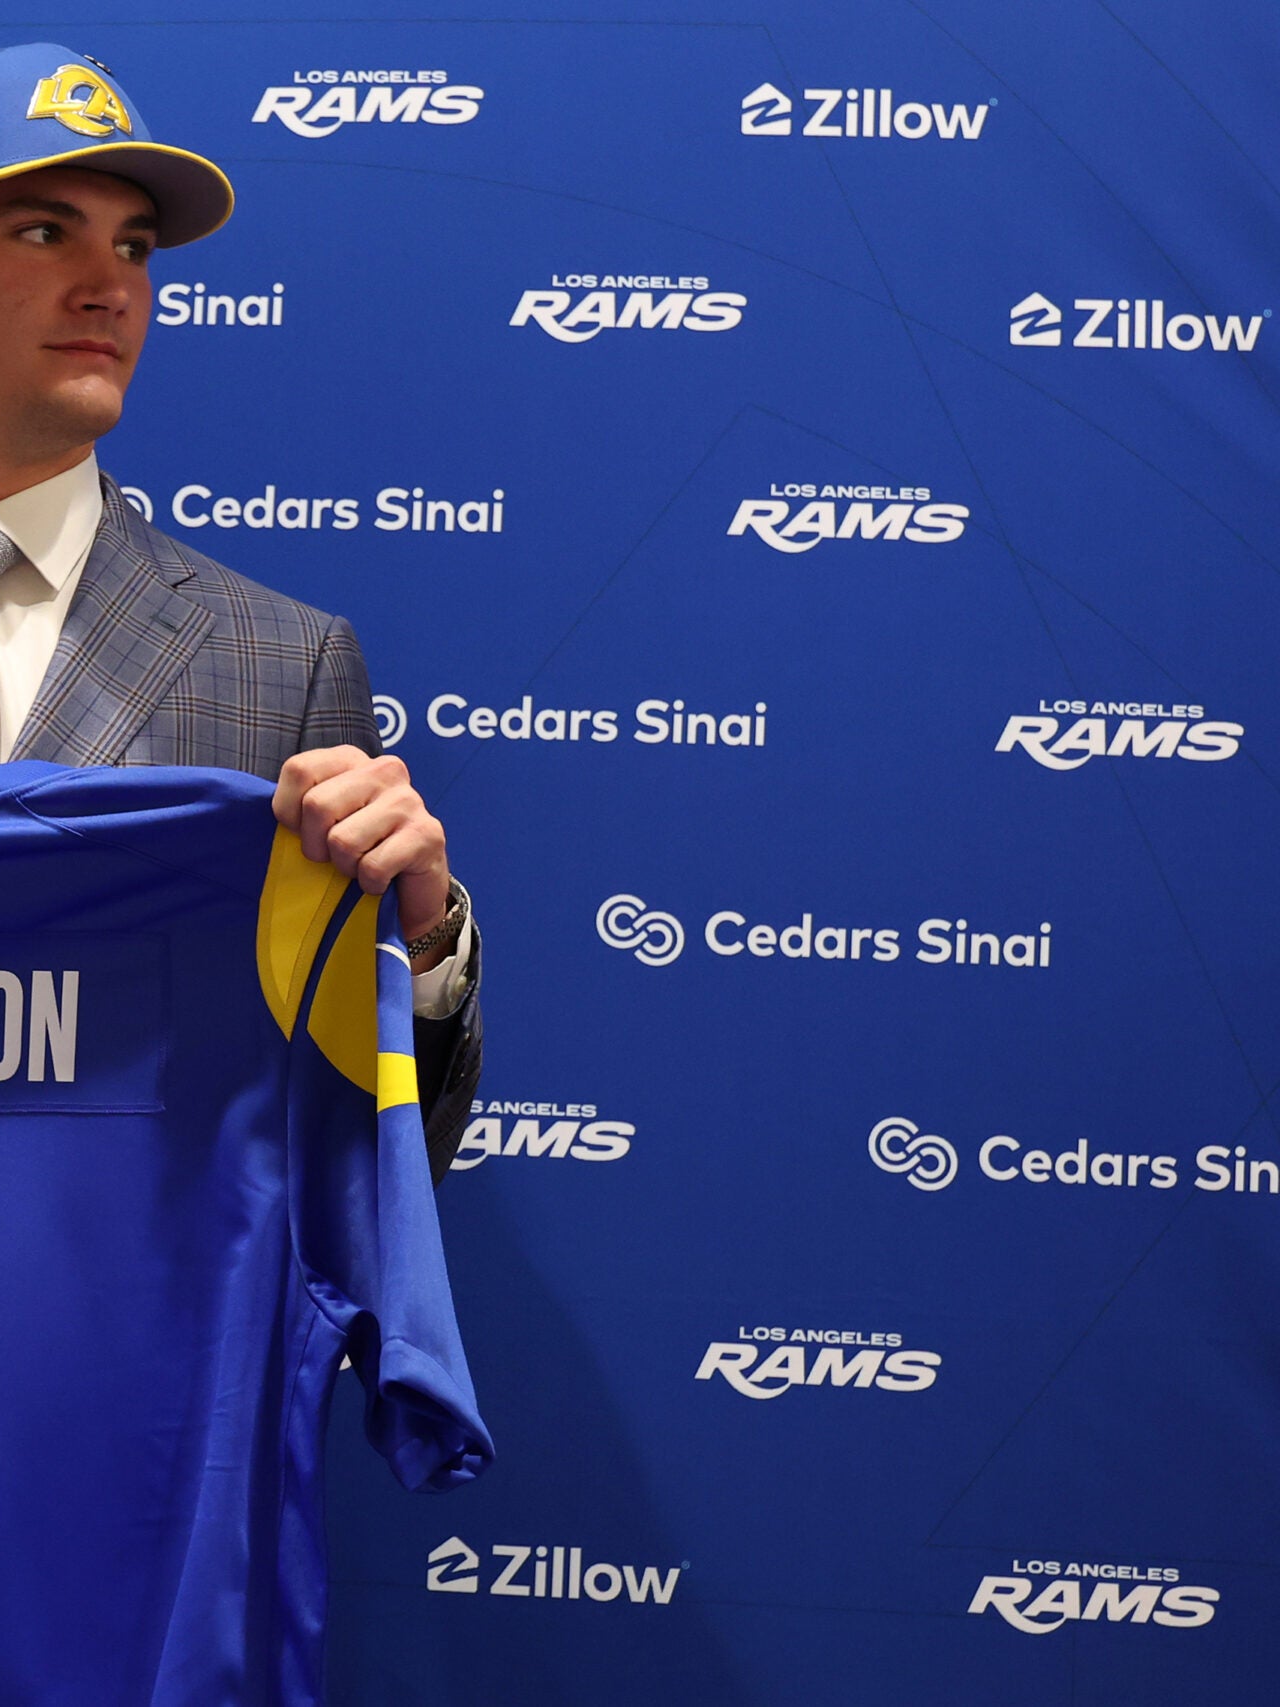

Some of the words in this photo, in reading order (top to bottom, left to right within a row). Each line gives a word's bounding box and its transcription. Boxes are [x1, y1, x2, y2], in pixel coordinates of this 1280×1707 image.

[294, 70, 339, 82] LOS
[341, 71, 447, 83] ANGELES
[252, 86, 484, 138] RAMS
[803, 88, 988, 139] Zillow
[156, 283, 284, 326] Sinai
[552, 275, 597, 288] LOS
[601, 276, 709, 290] ANGELES
[509, 290, 747, 343] RAMS
[1073, 299, 1262, 351] Zillow
[172, 485, 359, 529] Cedars
[375, 487, 504, 533] Sinai
[771, 484, 816, 497] LOS
[820, 485, 930, 501] ANGELES
[727, 500, 969, 553] RAMS
[427, 694, 618, 742] Cedars
[634, 700, 766, 746] Sinai
[1040, 700, 1086, 714] LOS
[1091, 702, 1204, 718] ANGELES
[995, 716, 1244, 770] RAMS
[705, 911, 899, 961] Cedars
[916, 919, 1051, 967] Sinai
[487, 1101, 596, 1117] ANGELES
[449, 1118, 635, 1171] AMS
[979, 1136, 1177, 1188] Cedars
[1195, 1146, 1280, 1193] Sin
[740, 1327, 786, 1341] LOS
[790, 1329, 901, 1346] ANGELES
[695, 1343, 941, 1399] RAMS
[491, 1545, 680, 1603] Zillow
[1013, 1560, 1060, 1574] LOS
[1065, 1563, 1179, 1582] ANGELES
[968, 1576, 1219, 1634] RAMS
